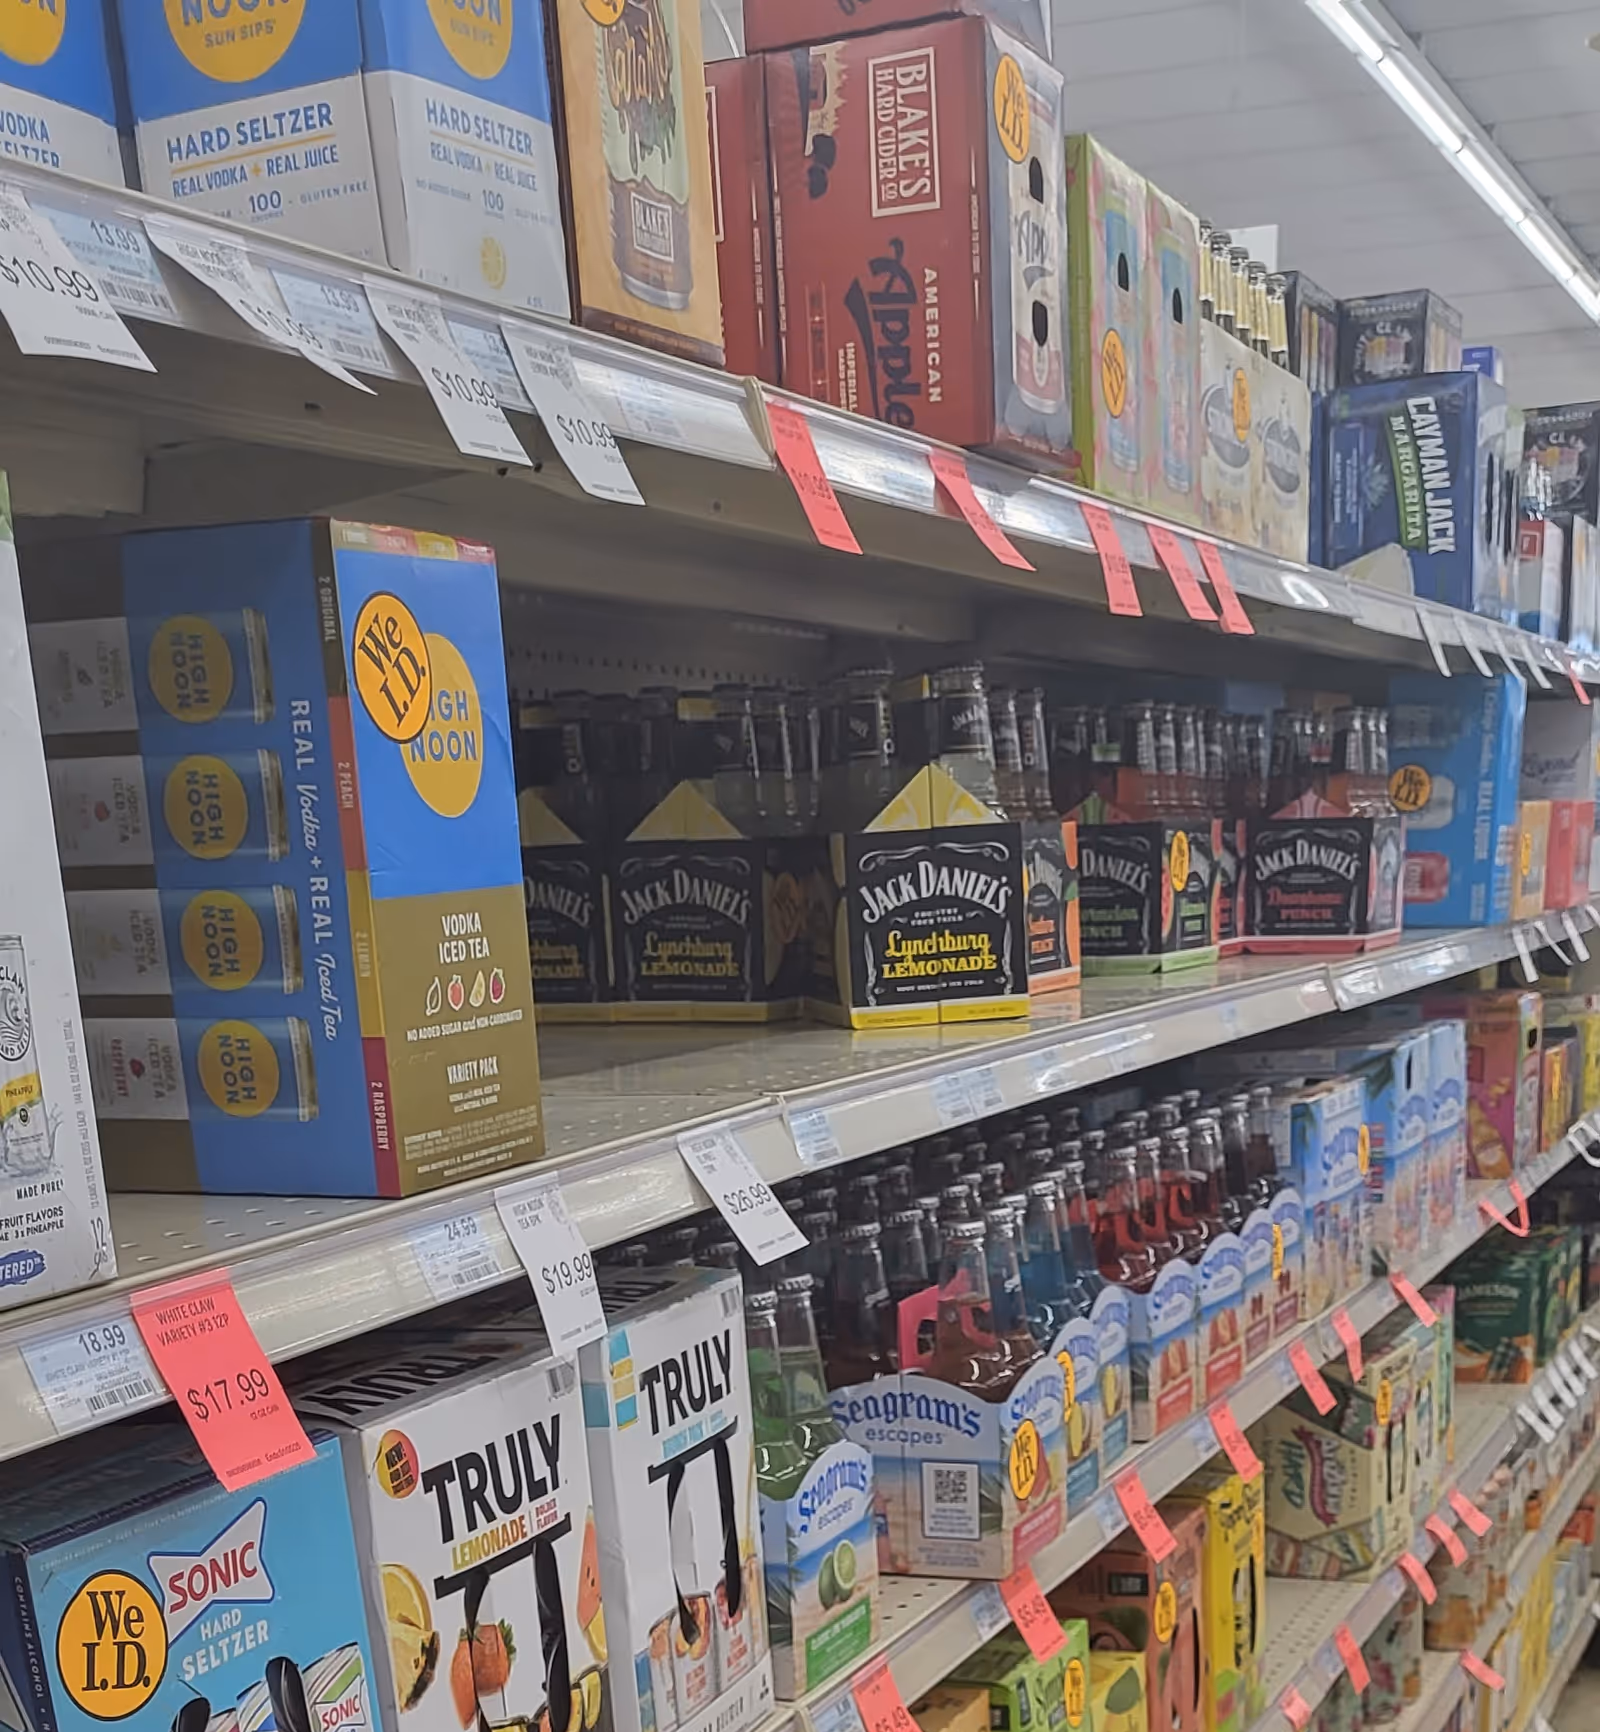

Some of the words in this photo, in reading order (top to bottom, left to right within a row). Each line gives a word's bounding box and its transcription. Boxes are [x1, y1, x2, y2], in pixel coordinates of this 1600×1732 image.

[205, 30, 235, 48] SUN
[876, 67, 894, 122] HARD
[168, 128, 230, 164] HARD
[237, 102, 333, 147] SELTZER
[426, 98, 471, 136] HARD
[474, 114, 533, 157] SELTZER
[877, 123, 897, 181] CIDER
[896, 61, 932, 199] BLAKE'S
[173, 174, 204, 199] REAL
[206, 164, 248, 193] VODKA
[266, 151, 301, 178] REAL
[304, 144, 340, 171] JUICE
[430, 142, 454, 164] REAL
[454, 149, 484, 174] VODKA
[494, 162, 517, 185] REAL
[517, 168, 538, 193] JUICE
[482, 188, 505, 213] 100
[90, 219, 140, 252] 13.99
[0, 258, 99, 302] $10.99
[922, 266, 943, 404] AMERICAN
[431, 366, 500, 410] $10.99
[845, 341, 858, 411] IMPERIAL
[556, 413, 617, 450] $10.99
[1406, 395, 1449, 490] CAYMAN
[1389, 414, 1424, 542] MARGARITA
[1424, 488, 1457, 556] JACK
[359, 612, 404, 677] We
[379, 645, 427, 729] I.D.
[290, 699, 315, 770] REAL
[410, 729, 478, 764] NOON
[185, 767, 208, 847] NOON
[202, 773, 225, 842] HIGH
[297, 783, 319, 852] Vodka
[1082, 848, 1152, 895] DANIEL'S
[1254, 845, 1294, 881] JACK
[1295, 839, 1361, 881] DANIEL'S
[310, 876, 335, 945] REAL
[620, 879, 670, 926] JACK
[672, 867, 753, 927] DANIEL'S
[859, 870, 918, 924] JACK
[917, 860, 1013, 917] DANIEL'S
[201, 904, 226, 980] NOON
[219, 907, 241, 975] HIGH
[438, 940, 467, 965] ICED
[467, 936, 491, 960] TEA
[441, 911, 483, 937] VODKA
[885, 928, 993, 965] Lynchburg
[315, 952, 334, 1002] Iced
[881, 954, 998, 979] LEMONADE
[320, 1002, 339, 1043] Tea
[406, 1028, 418, 1042] NO
[418, 1023, 441, 1042] ADDED
[441, 1020, 462, 1037] SUGAR
[217, 1033, 240, 1107] NOON
[234, 1037, 258, 1104] HIGH
[371, 1081, 383, 1091] 2
[446, 1061, 478, 1085] VARIETY
[479, 1055, 499, 1080] PACK
[371, 1093, 391, 1151] RASPBERRY
[26, 1207, 65, 1225] FLAVORS
[722, 1180, 773, 1217] $26.99
[26, 1219, 65, 1238] PINEAPPLE
[540, 1252, 592, 1298] $19.99
[155, 1302, 188, 1326] WHITE
[189, 1296, 216, 1316] CLAW
[157, 1325, 198, 1348] VARIETY
[198, 1317, 213, 1334] #3
[213, 1311, 230, 1331] 12P
[78, 1324, 126, 1356] 18.99
[186, 1367, 271, 1424] $17.99
[640, 1328, 736, 1435] TRULY
[828, 1391, 983, 1441] Seagram's
[864, 1426, 944, 1448] escapes
[421, 1413, 562, 1545] TRULY
[450, 1513, 528, 1571] LEMONADE
[168, 1540, 258, 1616] SONIC
[14, 1575, 33, 1644] CONTAINS
[25, 1644, 45, 1700] ALCOHOL
[86, 1590, 145, 1641] We
[200, 1607, 242, 1641] HARD
[81, 1640, 152, 1692] I.D.
[181, 1619, 270, 1682] SELTZER
[320, 1693, 362, 1732] SONIC
